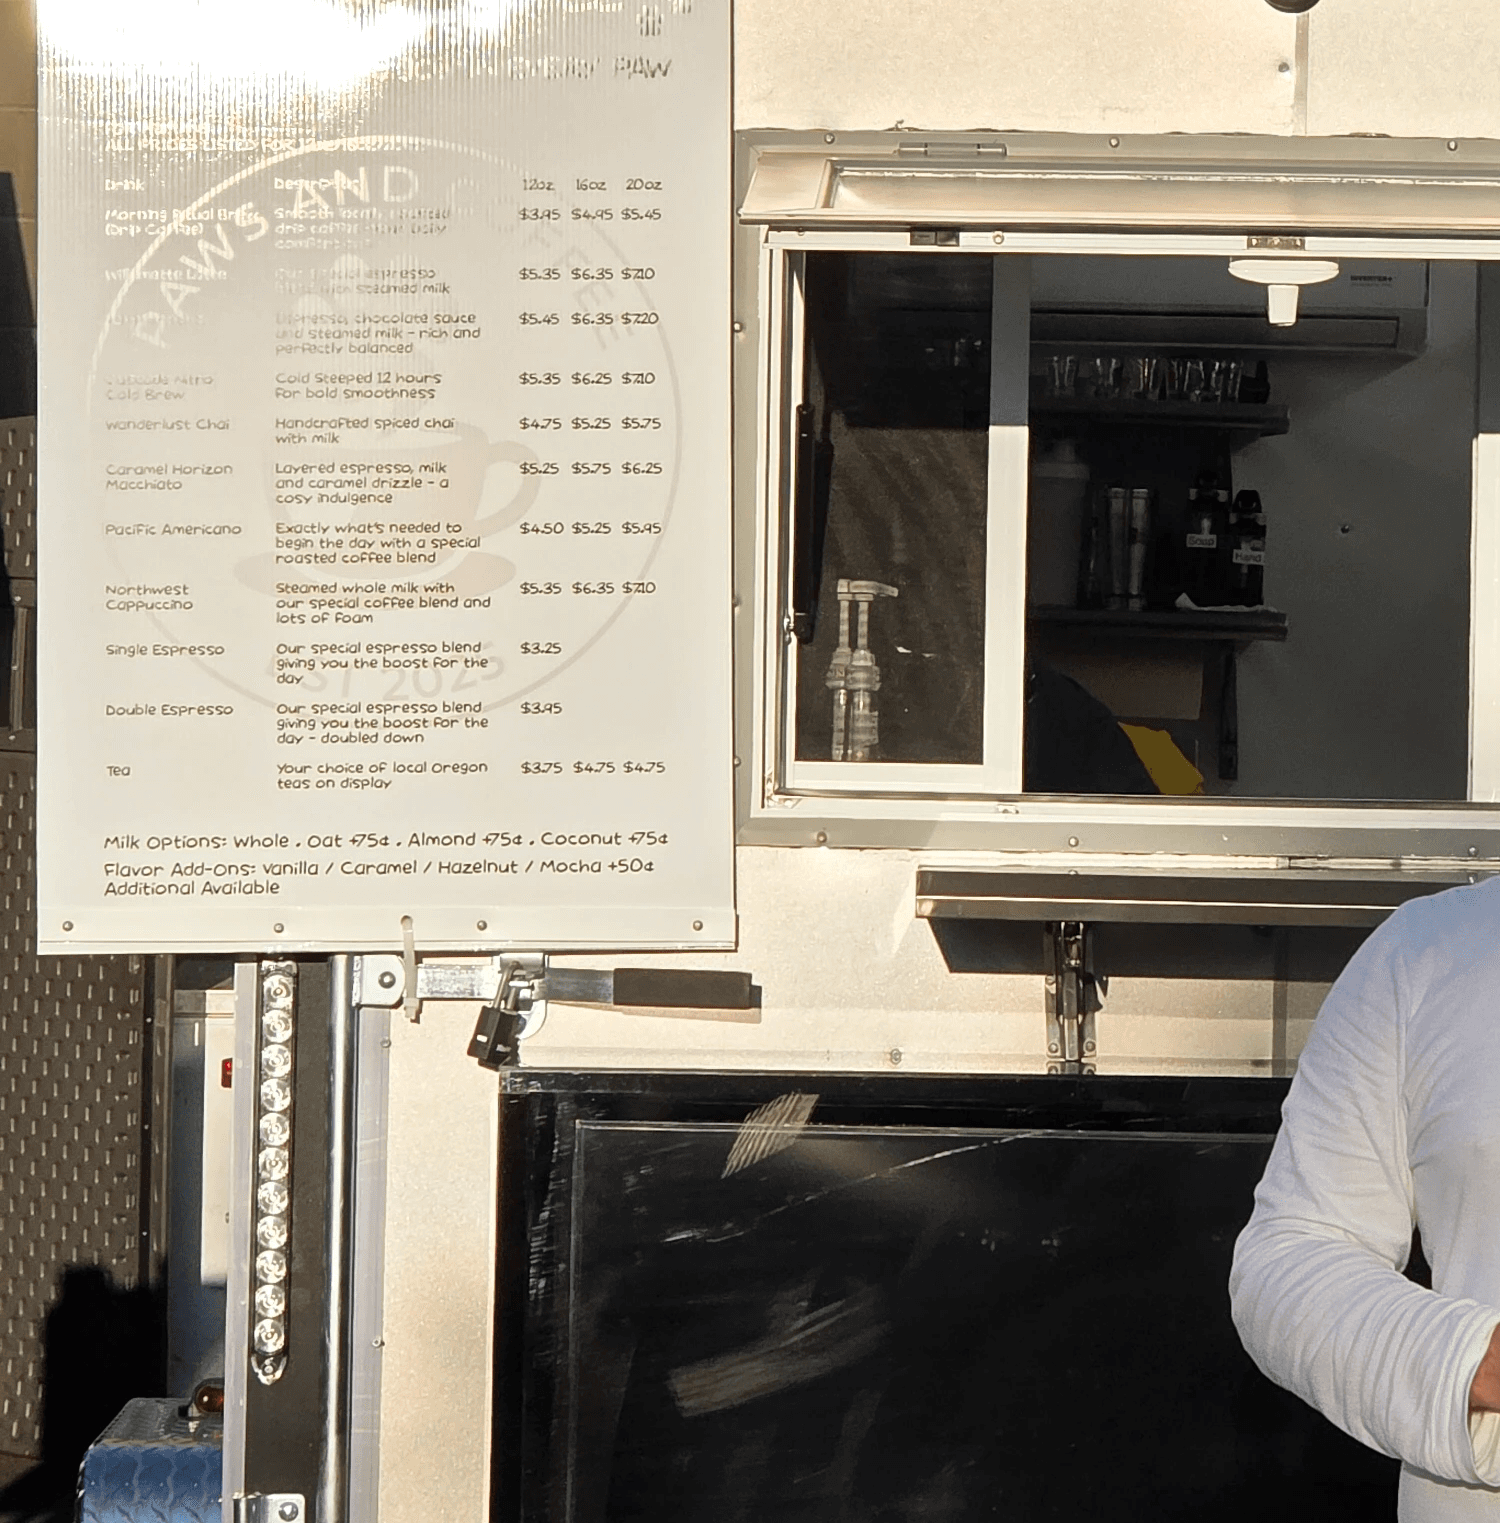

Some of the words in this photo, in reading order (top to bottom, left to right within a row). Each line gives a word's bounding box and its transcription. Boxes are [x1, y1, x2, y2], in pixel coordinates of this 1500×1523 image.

[576, 178, 607, 191] 16oz
[626, 178, 663, 191] 20oz
[518, 207, 561, 221] $3.95
[571, 208, 614, 221] $4.95
[620, 207, 662, 221] $5.45
[519, 267, 561, 280] $5.35
[571, 267, 614, 280] $6.35
[425, 282, 450, 295] milk
[355, 312, 428, 326] chocolate
[431, 313, 476, 325] sauce
[518, 312, 560, 325] $5.45
[571, 312, 614, 325] $6.35
[375, 327, 403, 339] milk
[419, 327, 449, 339] rich
[452, 327, 481, 339] and
[348, 342, 414, 354] balanced
[275, 373, 310, 384] Cold
[377, 371, 391, 384] 12
[395, 372, 442, 384] hours
[519, 372, 561, 385] $5.35
[571, 372, 612, 385] $6.25
[306, 386, 338, 399] bold
[343, 388, 436, 399] smoothness
[195, 418, 230, 431] Chai
[374, 417, 420, 431] spiced
[424, 417, 455, 429] chai
[519, 417, 562, 430] $4.75
[571, 417, 611, 430] $5.25
[621, 416, 661, 430] $5.75
[275, 432, 307, 444] with
[311, 431, 340, 444] milk
[106, 463, 168, 476] Caramel
[172, 464, 233, 476] Horizon
[275, 462, 335, 474] Layered
[339, 463, 414, 475] espresso,
[418, 461, 447, 474] milk
[519, 461, 559, 475] $5.25
[571, 461, 612, 475] $5.75
[621, 461, 663, 475] $6.25
[106, 479, 183, 491] Macchiato
[275, 477, 304, 489] and
[308, 476, 367, 489] caramel
[371, 476, 423, 489] drizzle
[317, 492, 393, 506] indulgence
[161, 523, 242, 535] Americano
[276, 522, 330, 535] Exactly
[334, 522, 385, 534] what's
[389, 521, 441, 534] needed
[446, 522, 462, 534] to
[519, 522, 564, 535] $4.50
[571, 521, 612, 535] $5.25
[621, 521, 662, 534] $5.95
[276, 537, 314, 551] begin
[319, 537, 344, 549] the
[348, 537, 376, 549] day
[380, 537, 412, 549] with
[430, 536, 481, 550] special
[276, 552, 337, 564] roasted
[396, 551, 436, 563] blend
[105, 584, 189, 596] Northwest
[276, 582, 337, 594] Steamed
[342, 582, 387, 594] whole
[391, 581, 419, 594] milk
[423, 582, 455, 594] with
[519, 581, 562, 595] $5.35
[572, 581, 615, 595] $6.35
[106, 599, 193, 612] Cappuccino
[276, 599, 304, 609] our
[309, 596, 359, 610] special
[419, 596, 459, 608] blend
[463, 596, 491, 609] and
[276, 612, 306, 624] lots
[106, 644, 148, 658] Single
[152, 644, 225, 657] Espresso
[276, 643, 306, 655] Our
[310, 642, 361, 655] special
[365, 643, 438, 655] espresso
[442, 641, 482, 653] blend
[520, 641, 562, 655] $3.25
[276, 658, 316, 671] giving
[320, 659, 348, 669] you
[354, 657, 378, 669] the
[382, 656, 429, 669] boost
[463, 657, 488, 668] the
[276, 672, 304, 685] day
[106, 703, 157, 716] Double
[161, 704, 234, 717] Espresso
[276, 703, 306, 714] Our
[311, 701, 361, 715] special
[366, 703, 438, 715] espresso
[442, 701, 482, 713] blend
[520, 701, 563, 714] $3.95
[277, 718, 316, 731] giving
[320, 719, 349, 730] you
[354, 717, 379, 729] the
[383, 716, 429, 729] boost
[464, 717, 489, 728] the
[277, 732, 304, 745] day
[320, 731, 379, 744] doubled
[383, 732, 424, 744] down
[106, 765, 131, 777] Tea
[317, 763, 364, 774] choice
[393, 761, 427, 773] local
[521, 761, 563, 774] $3.75
[573, 761, 616, 774] $4.75
[623, 760, 666, 773] $4.75
[277, 778, 311, 790] teas
[315, 779, 335, 789] on
[340, 776, 392, 790] display
[104, 834, 140, 849] Milk
[307, 834, 343, 848] Oat
[408, 832, 476, 847] Almond
[541, 832, 622, 846] Coconut
[104, 862, 164, 877] Flavor
[340, 860, 417, 875] Caramel
[438, 859, 519, 874] Hazelnut
[540, 859, 602, 873] Mocha
[607, 858, 654, 873] +50¢
[104, 880, 195, 896] Additional
[201, 879, 280, 895] Available
